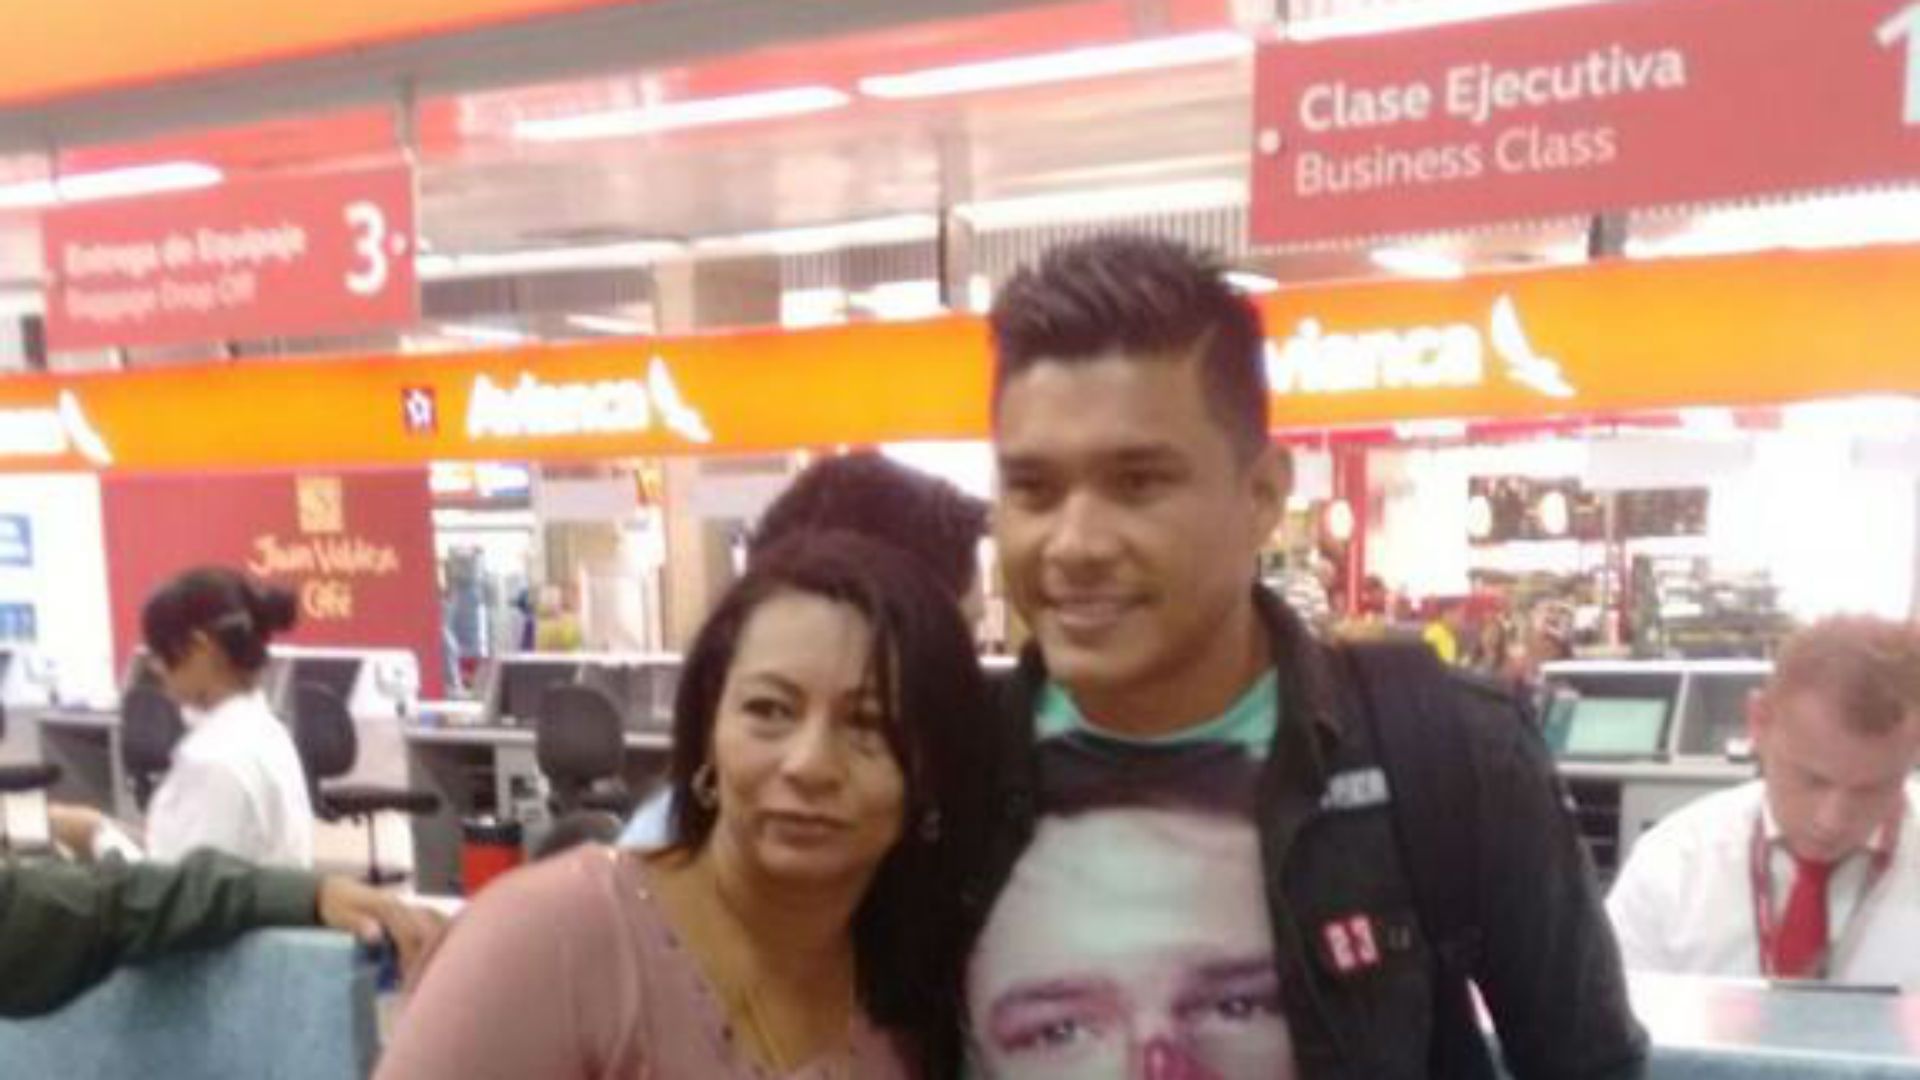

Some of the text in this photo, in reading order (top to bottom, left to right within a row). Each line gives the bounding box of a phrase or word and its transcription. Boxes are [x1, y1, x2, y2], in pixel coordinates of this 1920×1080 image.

[1299, 46, 1686, 132] Clase Ejecutiva
[1295, 121, 1617, 196] Business Class
[343, 200, 389, 297] 3
[1263, 316, 1484, 394] vianca
